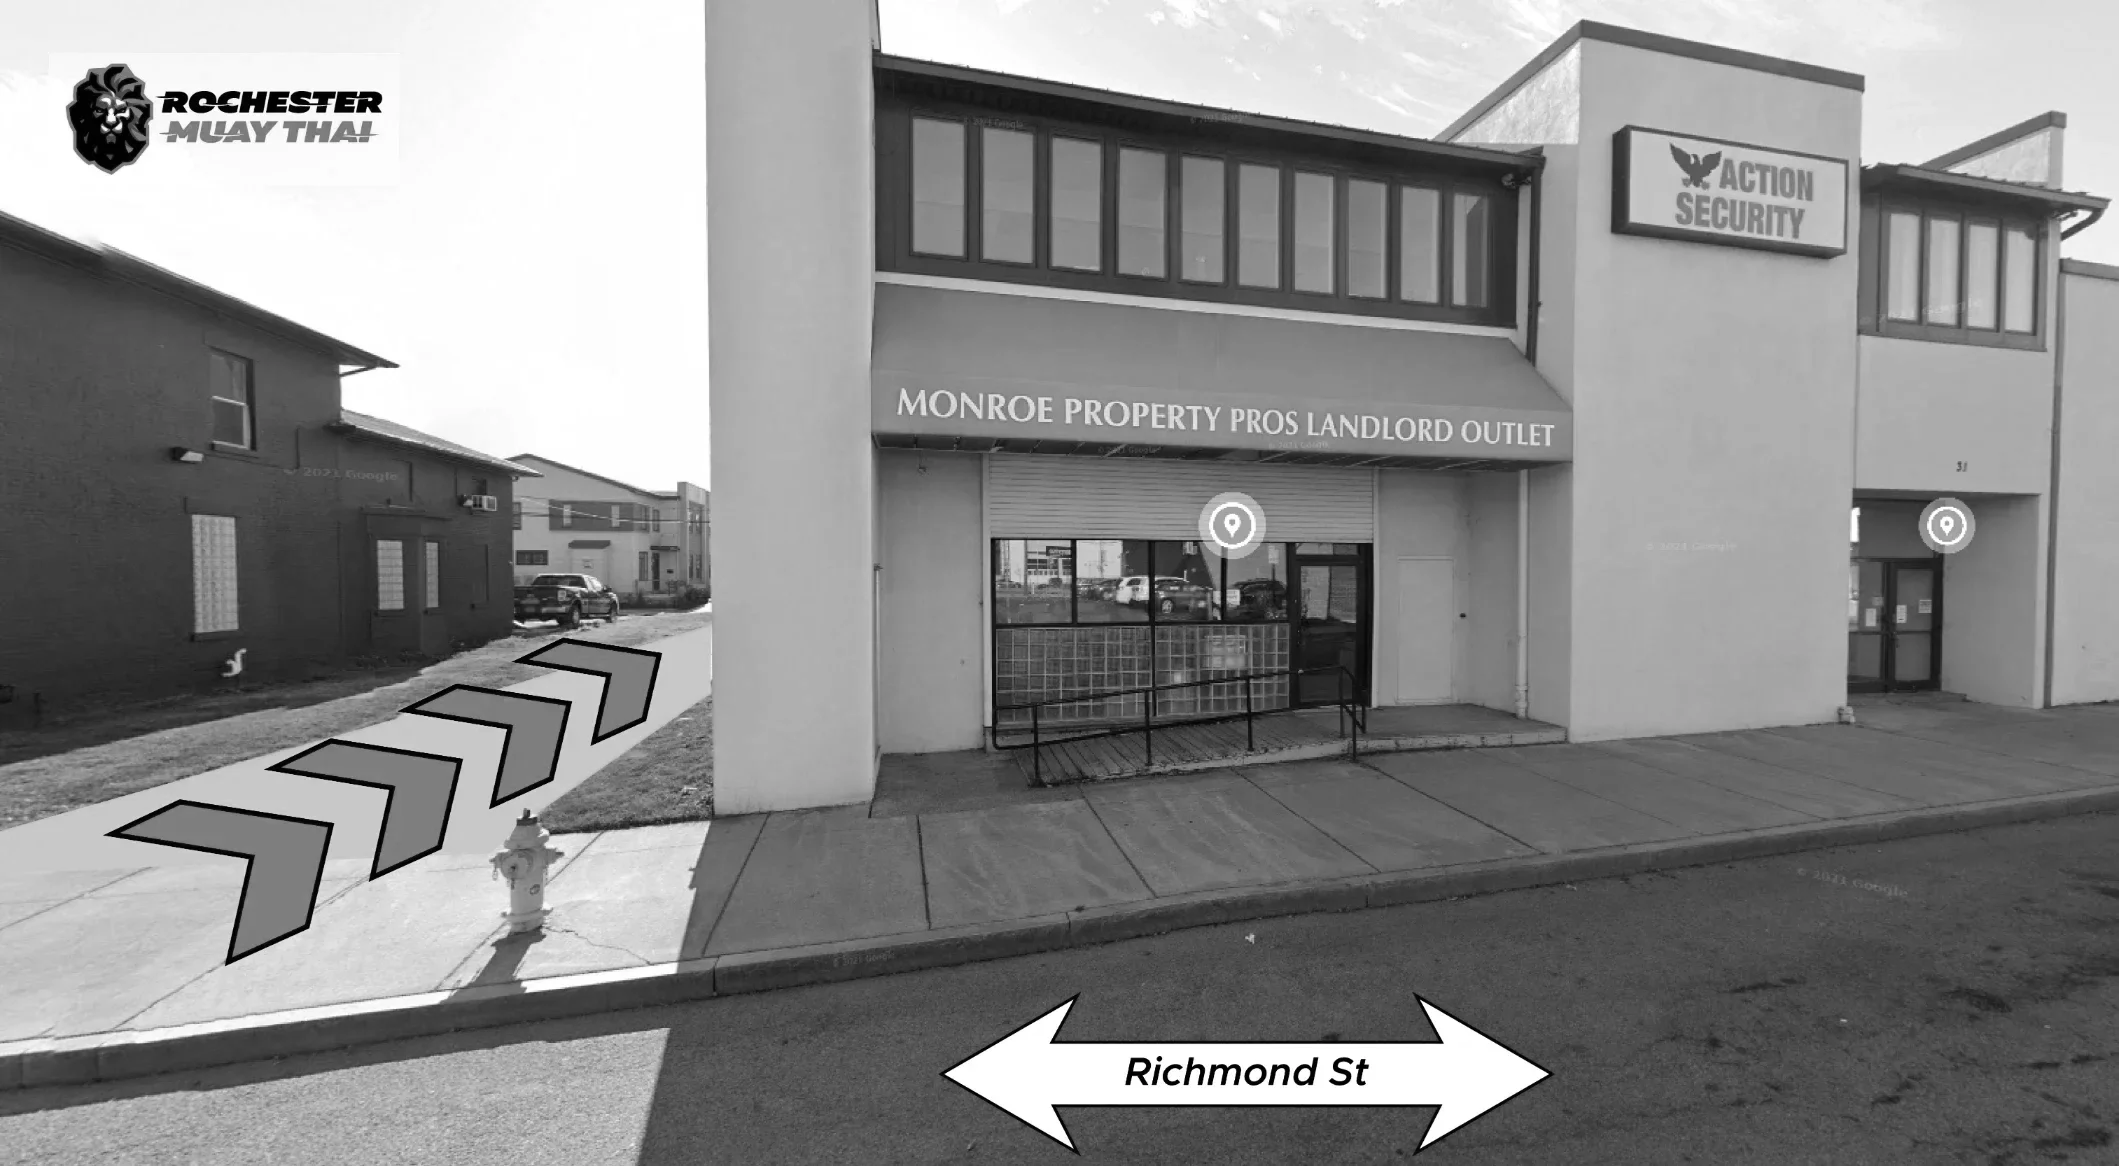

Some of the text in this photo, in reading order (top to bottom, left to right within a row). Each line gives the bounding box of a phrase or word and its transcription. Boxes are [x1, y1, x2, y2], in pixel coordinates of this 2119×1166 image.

[1718, 158, 1813, 203] ACTION
[1674, 191, 1806, 240] SECURITY
[897, 387, 1555, 447] MONROE PROPERTY PROS LANDLORD OUTLET
[1955, 460, 1968, 473] 31
